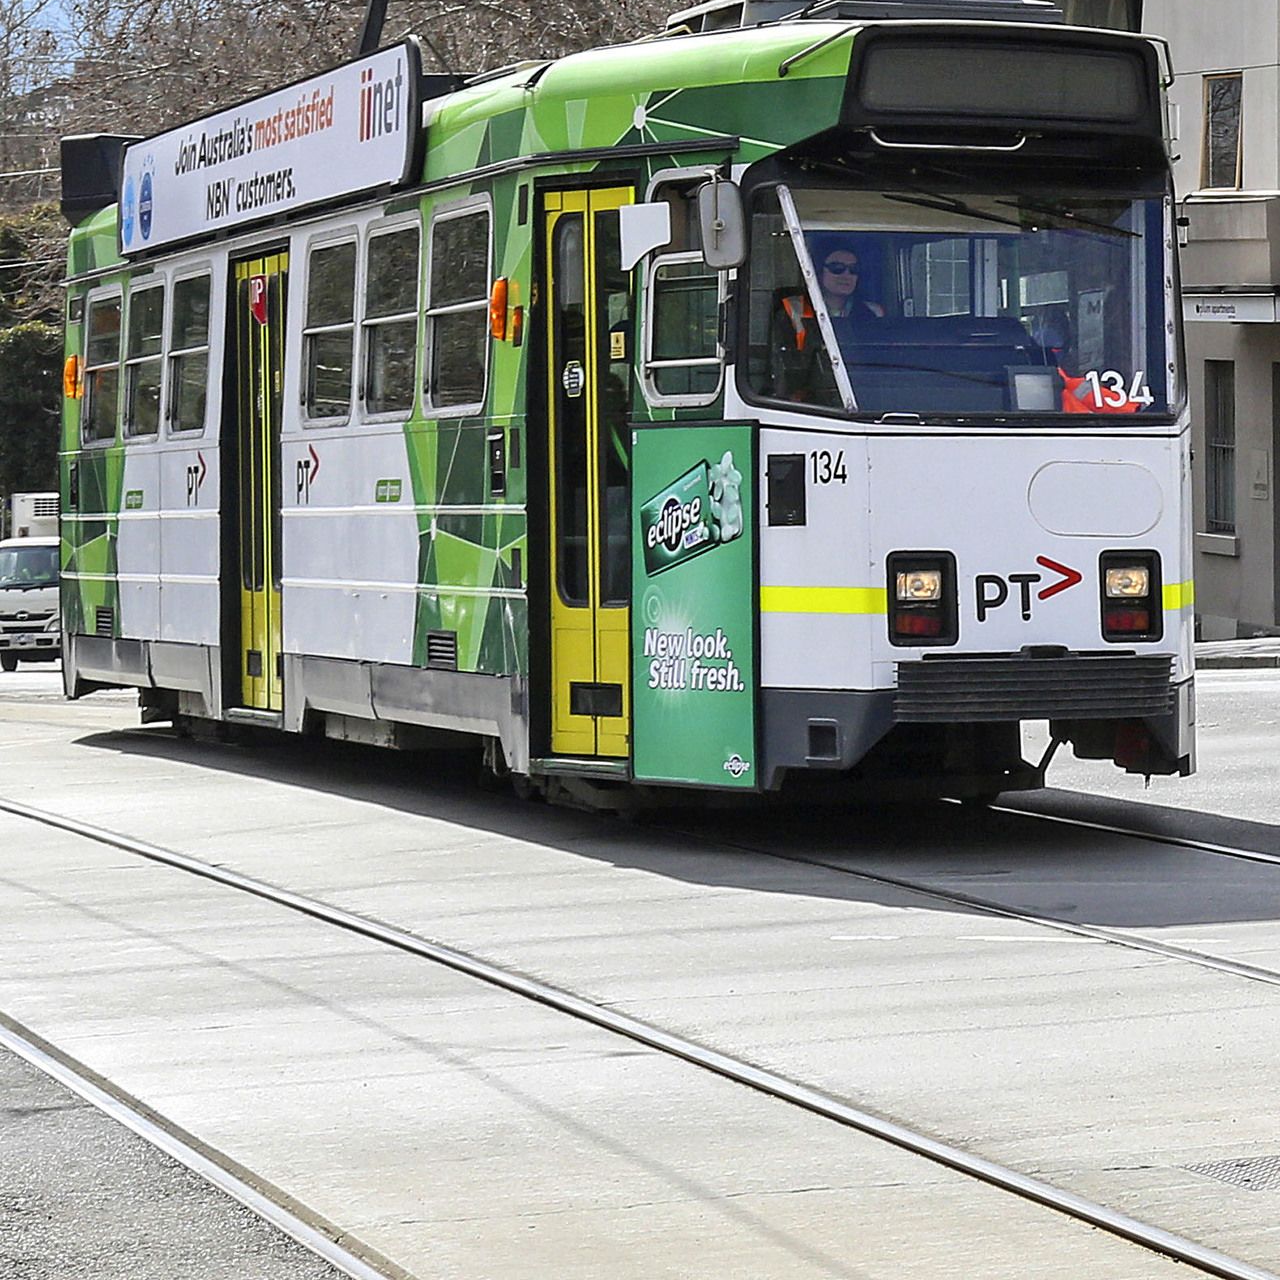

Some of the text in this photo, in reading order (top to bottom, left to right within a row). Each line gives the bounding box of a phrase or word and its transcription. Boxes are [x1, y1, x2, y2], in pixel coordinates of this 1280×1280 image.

[360, 58, 403, 143] iinet
[175, 84, 335, 177] Join Australia's most satisfied
[236, 167, 296, 210] customers.
[1086, 370, 1155, 409] 134
[810, 450, 847, 484] 134
[647, 496, 701, 549] eclipse
[643, 627, 732, 659] New look.
[649, 658, 745, 692] Still fresh.
